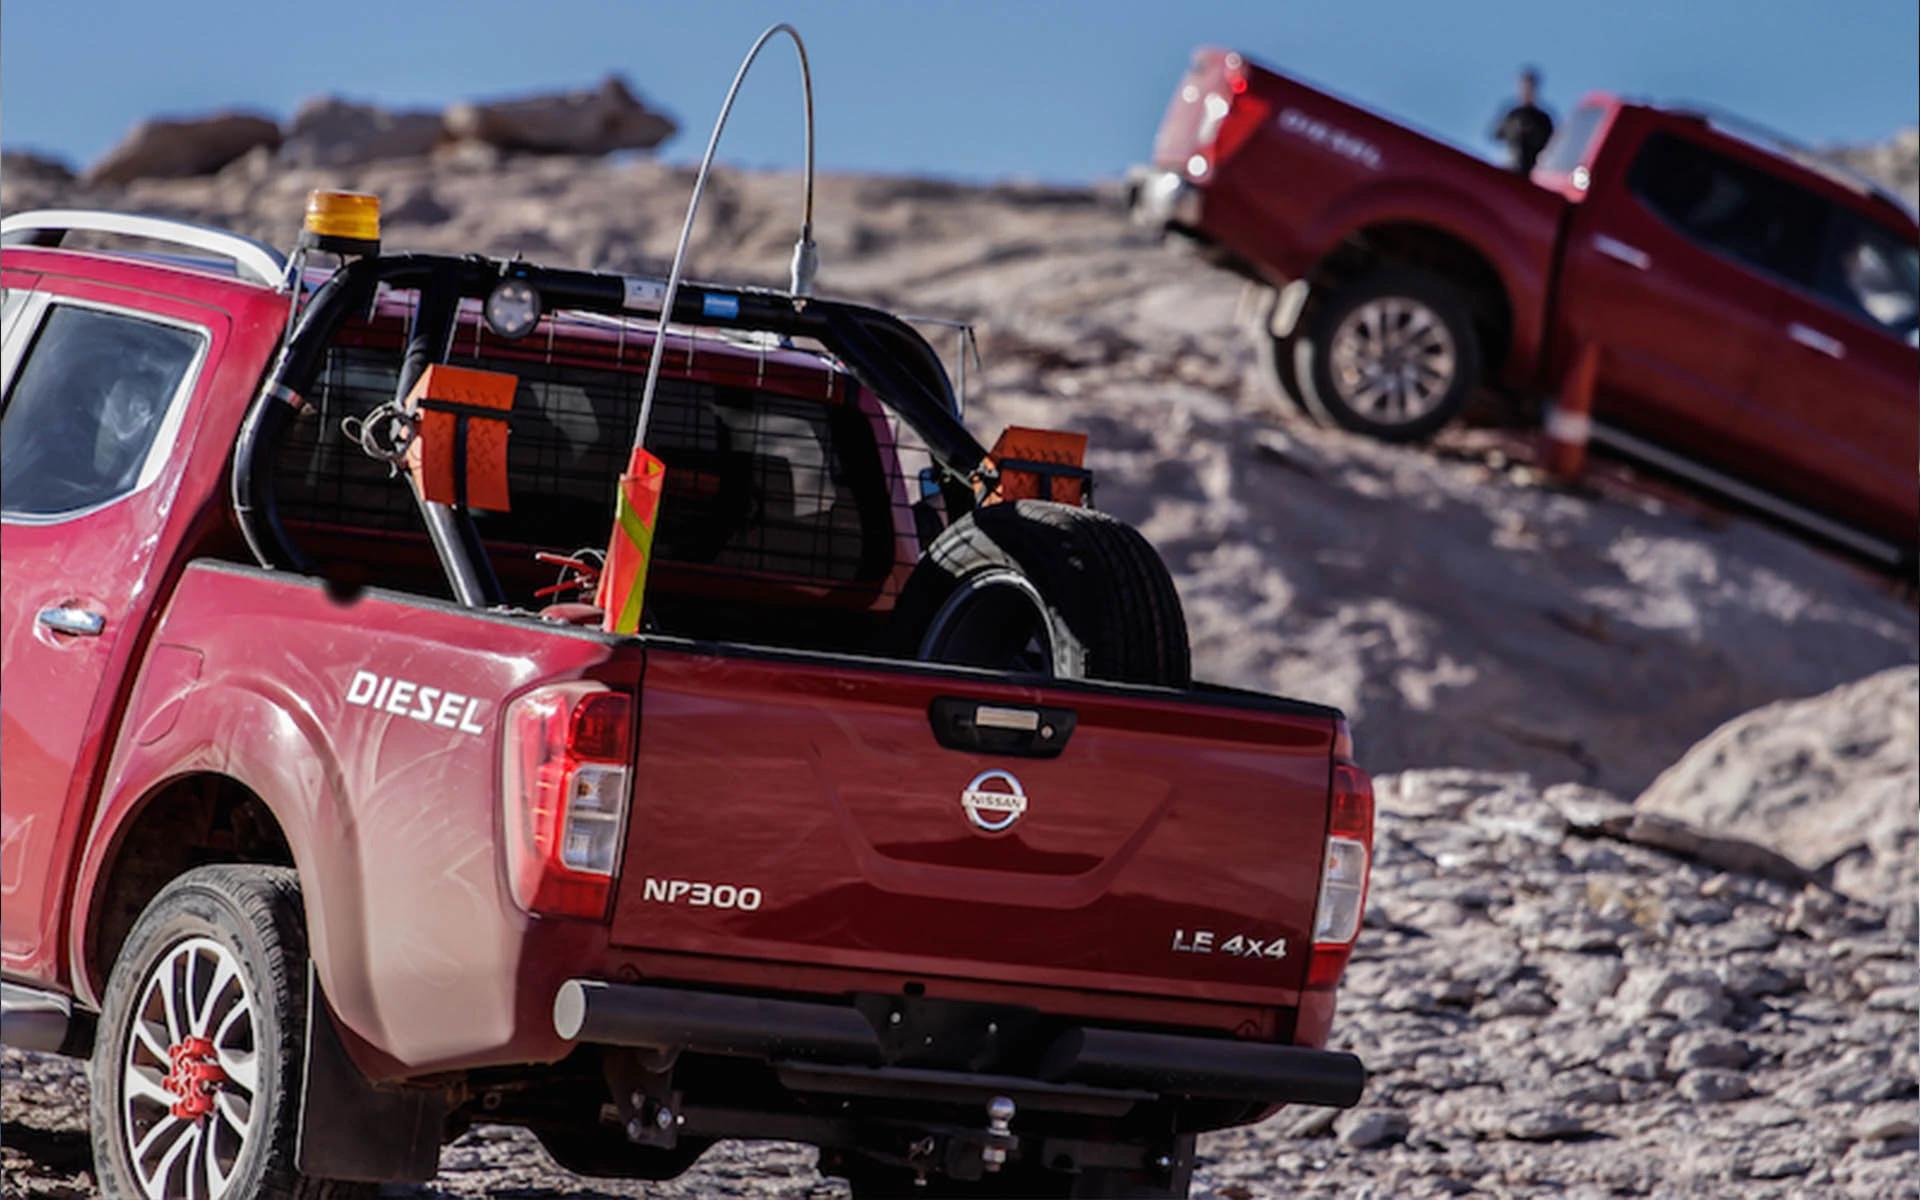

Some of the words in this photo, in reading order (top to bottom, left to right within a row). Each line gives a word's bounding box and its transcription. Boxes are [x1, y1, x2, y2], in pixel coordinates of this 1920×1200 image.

[346, 669, 484, 735] DIESEL
[970, 793, 1020, 809] NISSAN
[643, 878, 762, 911] NP300
[1172, 929, 1215, 953] LE
